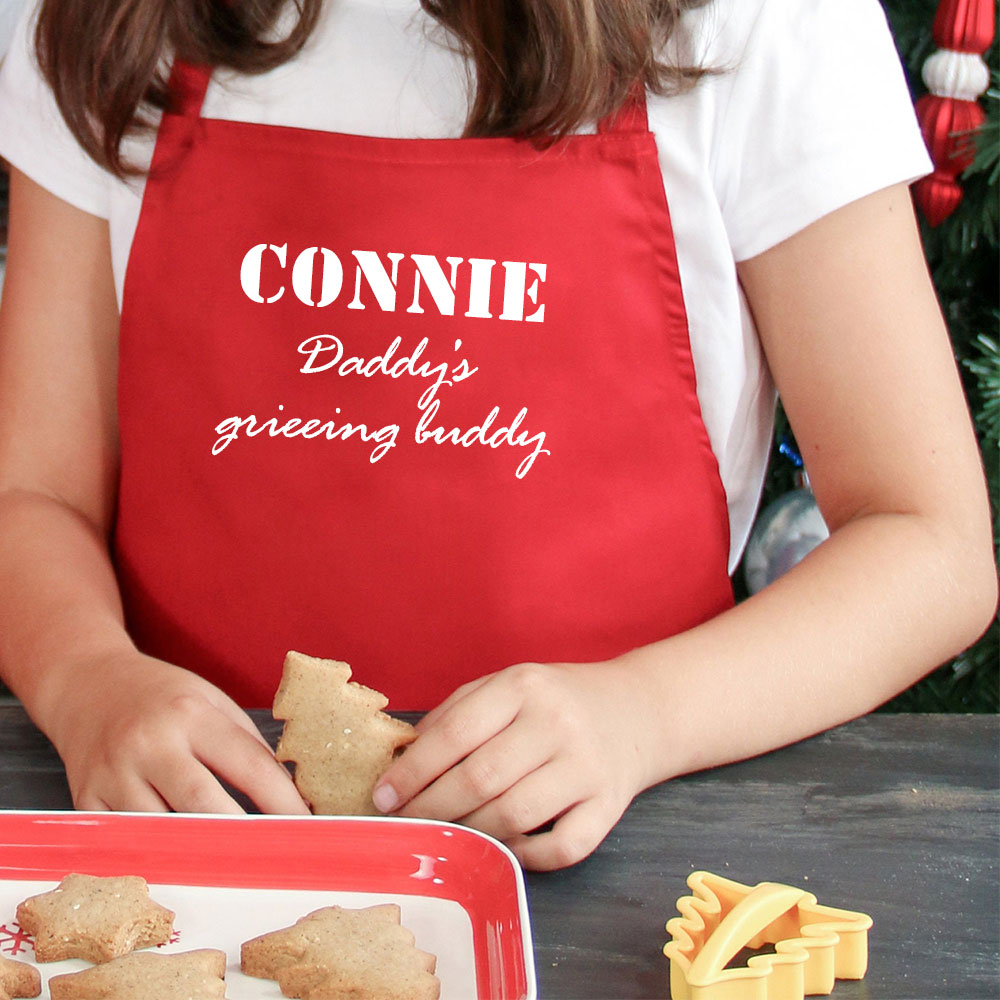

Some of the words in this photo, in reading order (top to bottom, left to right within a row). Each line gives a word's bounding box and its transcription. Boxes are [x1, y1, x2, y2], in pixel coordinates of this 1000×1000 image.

[240, 242, 547, 323] CONNIE
[297, 334, 479, 410] Daddy's
[414, 398, 551, 480] buddy
